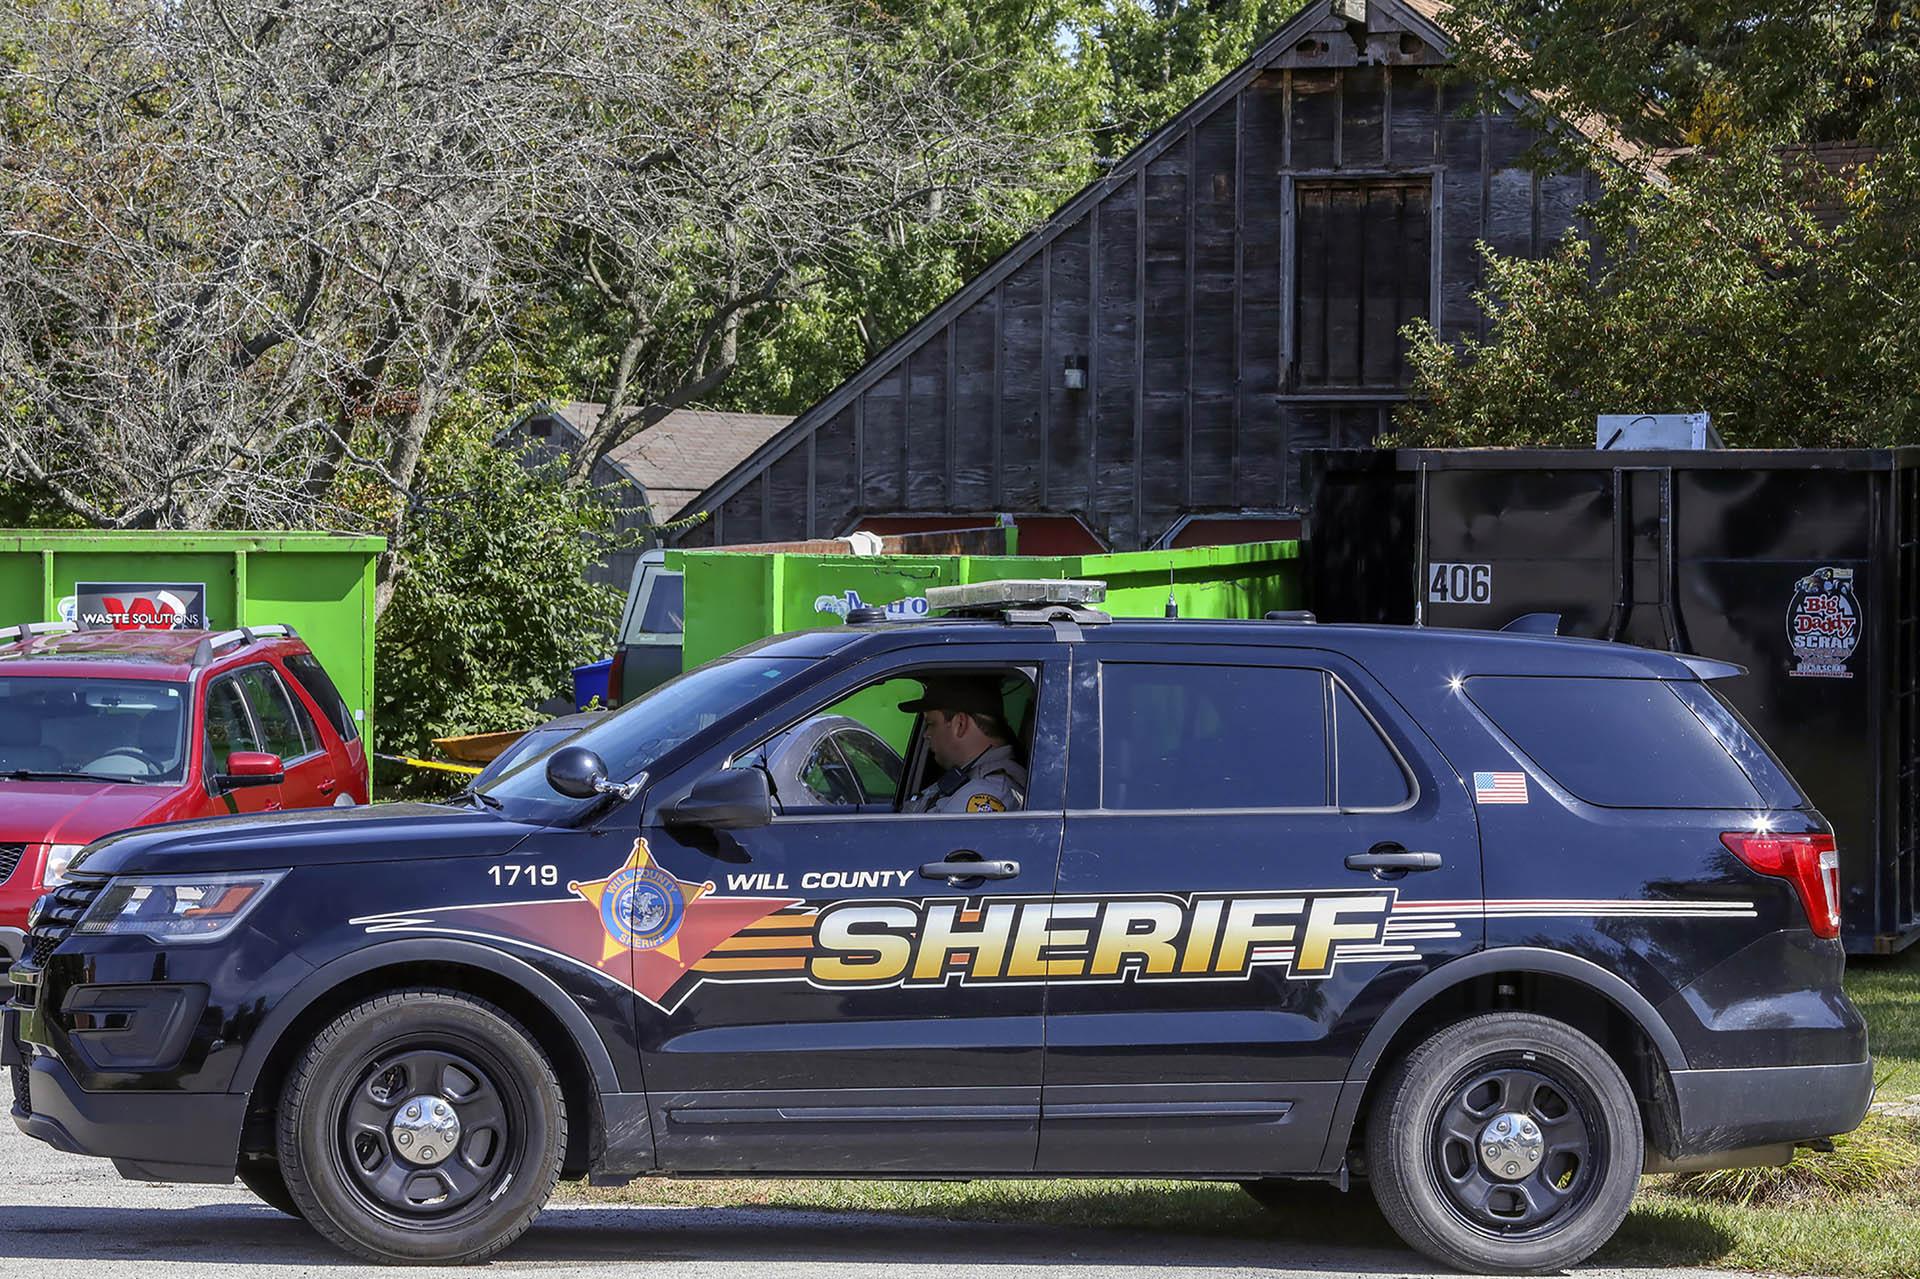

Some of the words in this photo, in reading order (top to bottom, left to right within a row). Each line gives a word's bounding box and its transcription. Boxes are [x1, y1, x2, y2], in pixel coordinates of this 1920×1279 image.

[1431, 565, 1489, 602] 406
[1804, 596, 1838, 614] Big
[82, 613, 130, 624] WASTE
[132, 613, 199, 624] SOLUTIONS
[1797, 614, 1856, 637] Daddy
[1794, 635, 1855, 649] SCRAP
[487, 864, 558, 886] 1719
[606, 872, 630, 894] WILL
[633, 868, 678, 893] COUNTY
[727, 873, 789, 891] WILL
[801, 870, 914, 889] COUNTY
[619, 933, 665, 948] SHERIFF
[809, 893, 1389, 982] SHERIFF
